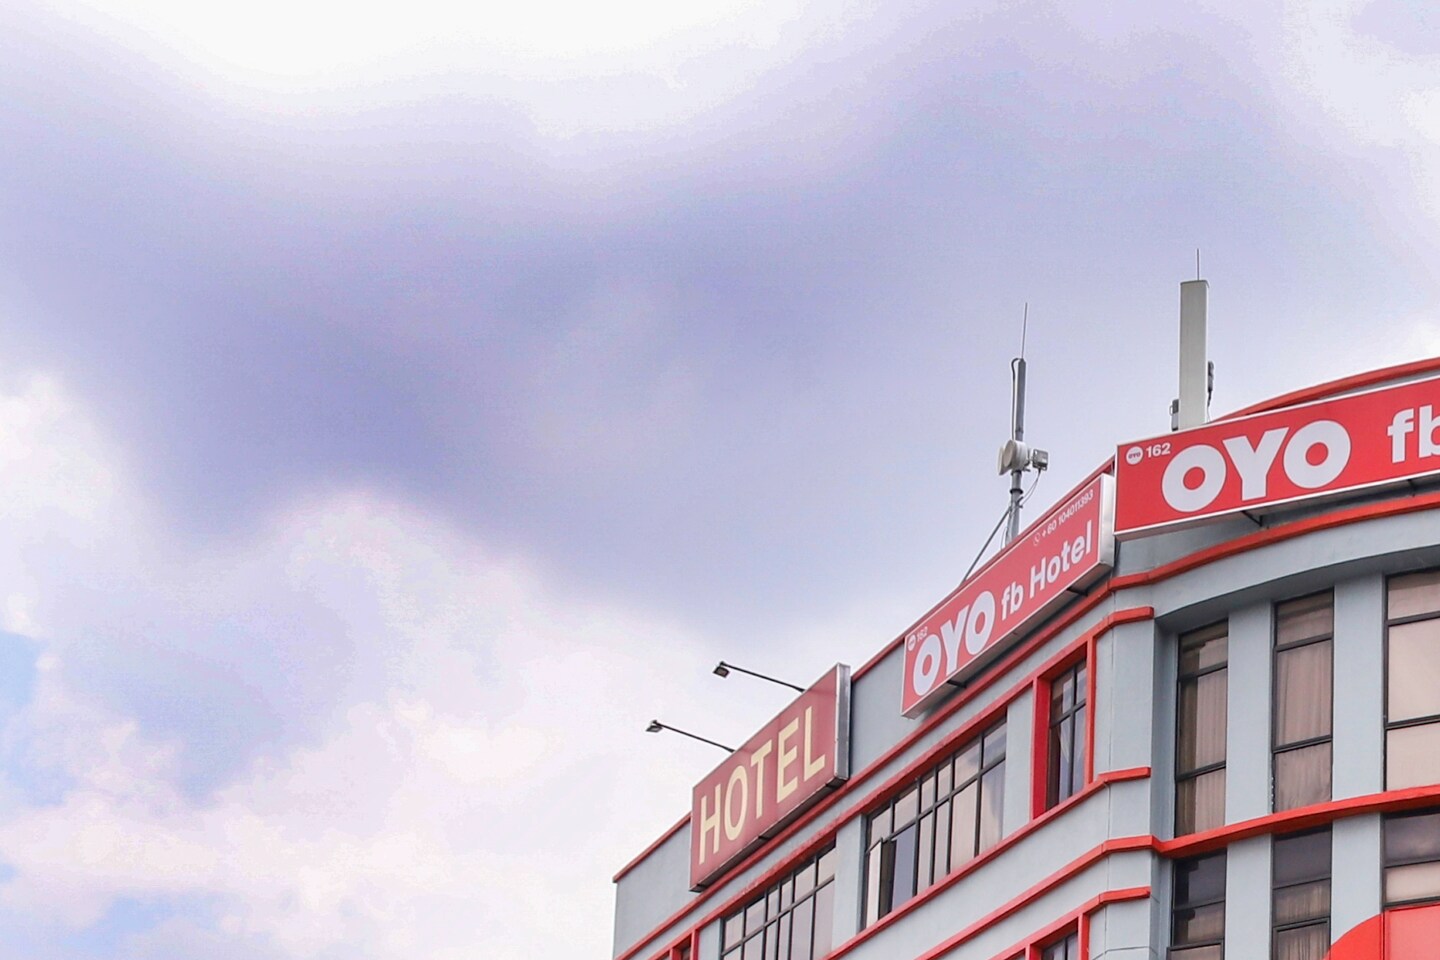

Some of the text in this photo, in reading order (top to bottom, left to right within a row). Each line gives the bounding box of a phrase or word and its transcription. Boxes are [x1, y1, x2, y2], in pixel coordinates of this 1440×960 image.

[1146, 442, 1171, 458] 162
[1161, 419, 1352, 513] OYO
[913, 520, 1092, 697] OYO fb Hotel
[699, 705, 826, 865] HOTEL
